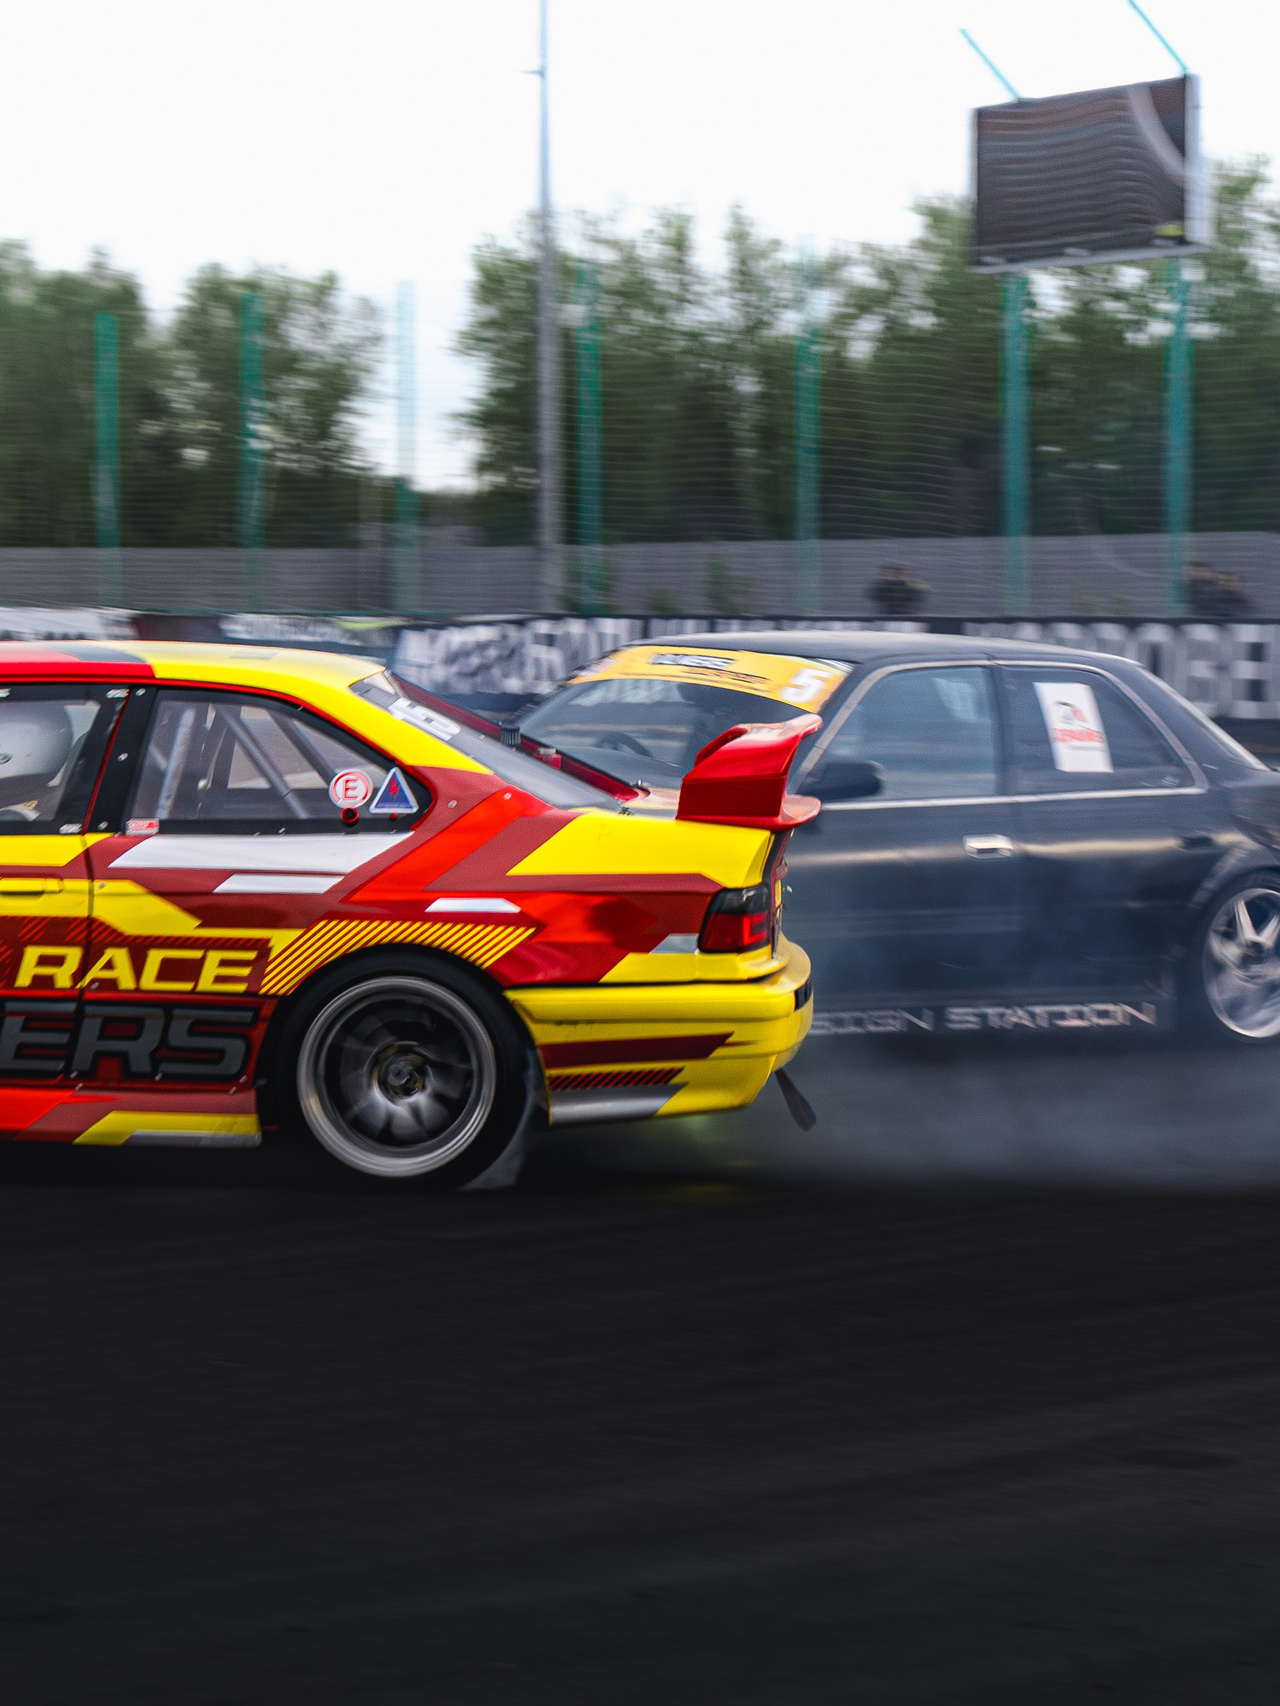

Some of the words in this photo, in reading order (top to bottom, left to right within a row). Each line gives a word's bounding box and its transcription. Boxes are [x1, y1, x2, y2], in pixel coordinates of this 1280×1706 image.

[779, 667, 832, 704] 5
[341, 778, 360, 801] E
[14, 944, 260, 993] RACE
[943, 1001, 1158, 1031] STATION
